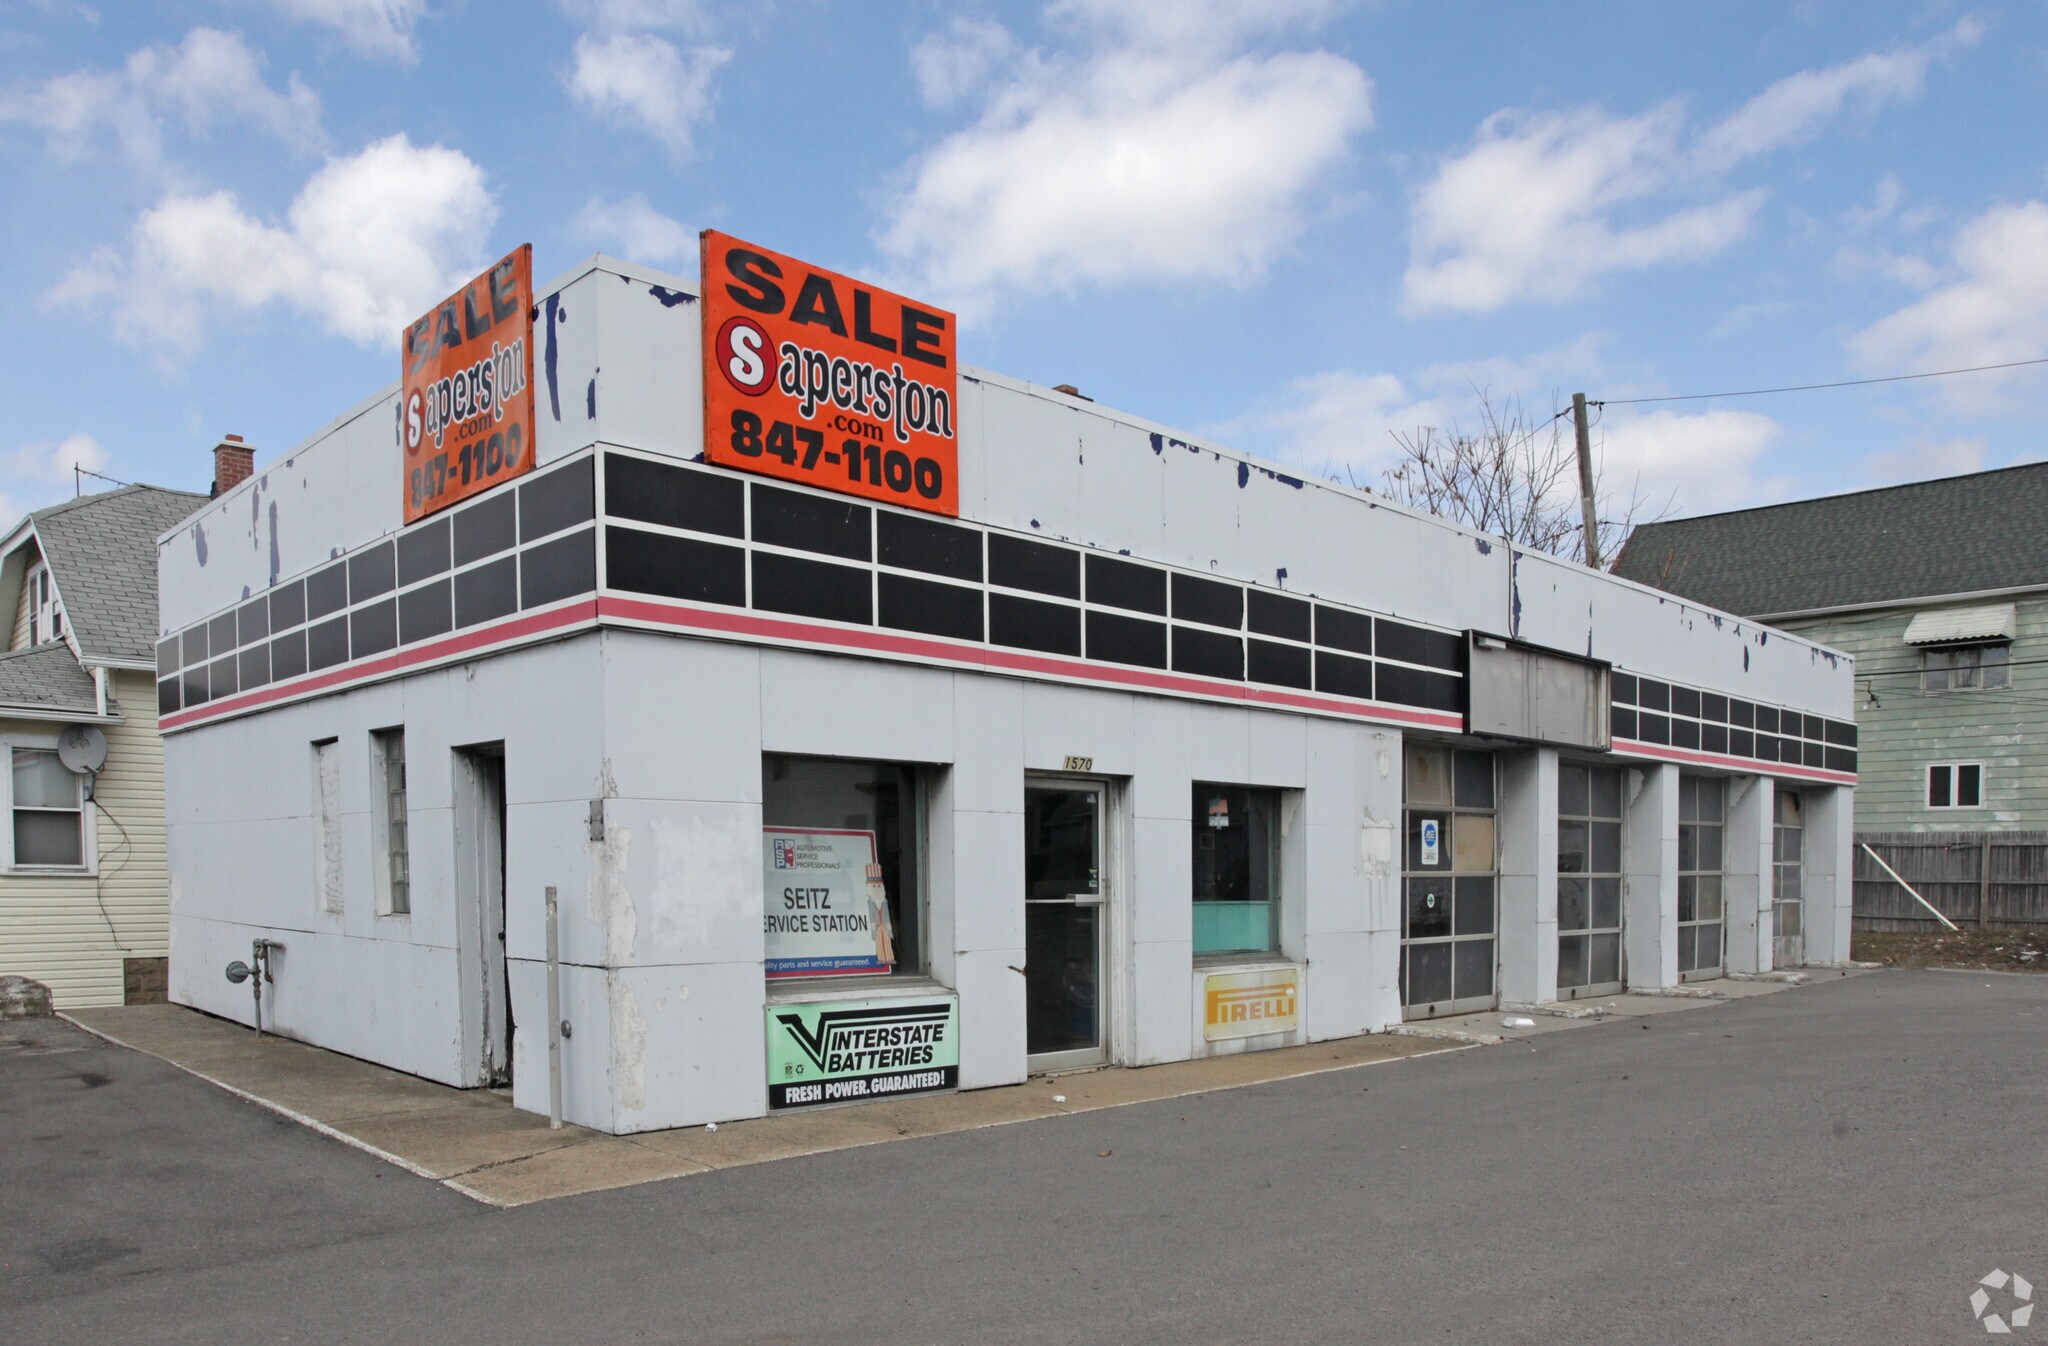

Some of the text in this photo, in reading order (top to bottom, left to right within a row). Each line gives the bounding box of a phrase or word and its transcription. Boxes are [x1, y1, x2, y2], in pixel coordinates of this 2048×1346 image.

[408, 257, 518, 375] SALE
[725, 248, 946, 369] SALE
[454, 413, 492, 442] .com
[826, 414, 884, 442] .com
[411, 422, 522, 508] 847-1100
[730, 408, 942, 500] 847-1100
[1066, 757, 1092, 770] 1570
[796, 844, 832, 852] AUTOMOTIVE
[796, 861, 840, 869] PROFESSIONALS
[784, 887, 831, 910] SEITZ
[764, 914, 868, 933] RVICE STATION
[779, 961, 795, 970] parts
[797, 960, 809, 968] and
[810, 959, 833, 967] service
[834, 958, 870, 968] guaranteed.
[1207, 984, 1296, 1024] PIRELLI
[831, 1023, 945, 1051] INTERSTATE
[828, 1045, 933, 1073] BATTERIES
[785, 1070, 945, 1104] FRESH POWER. GUARANTEED!
